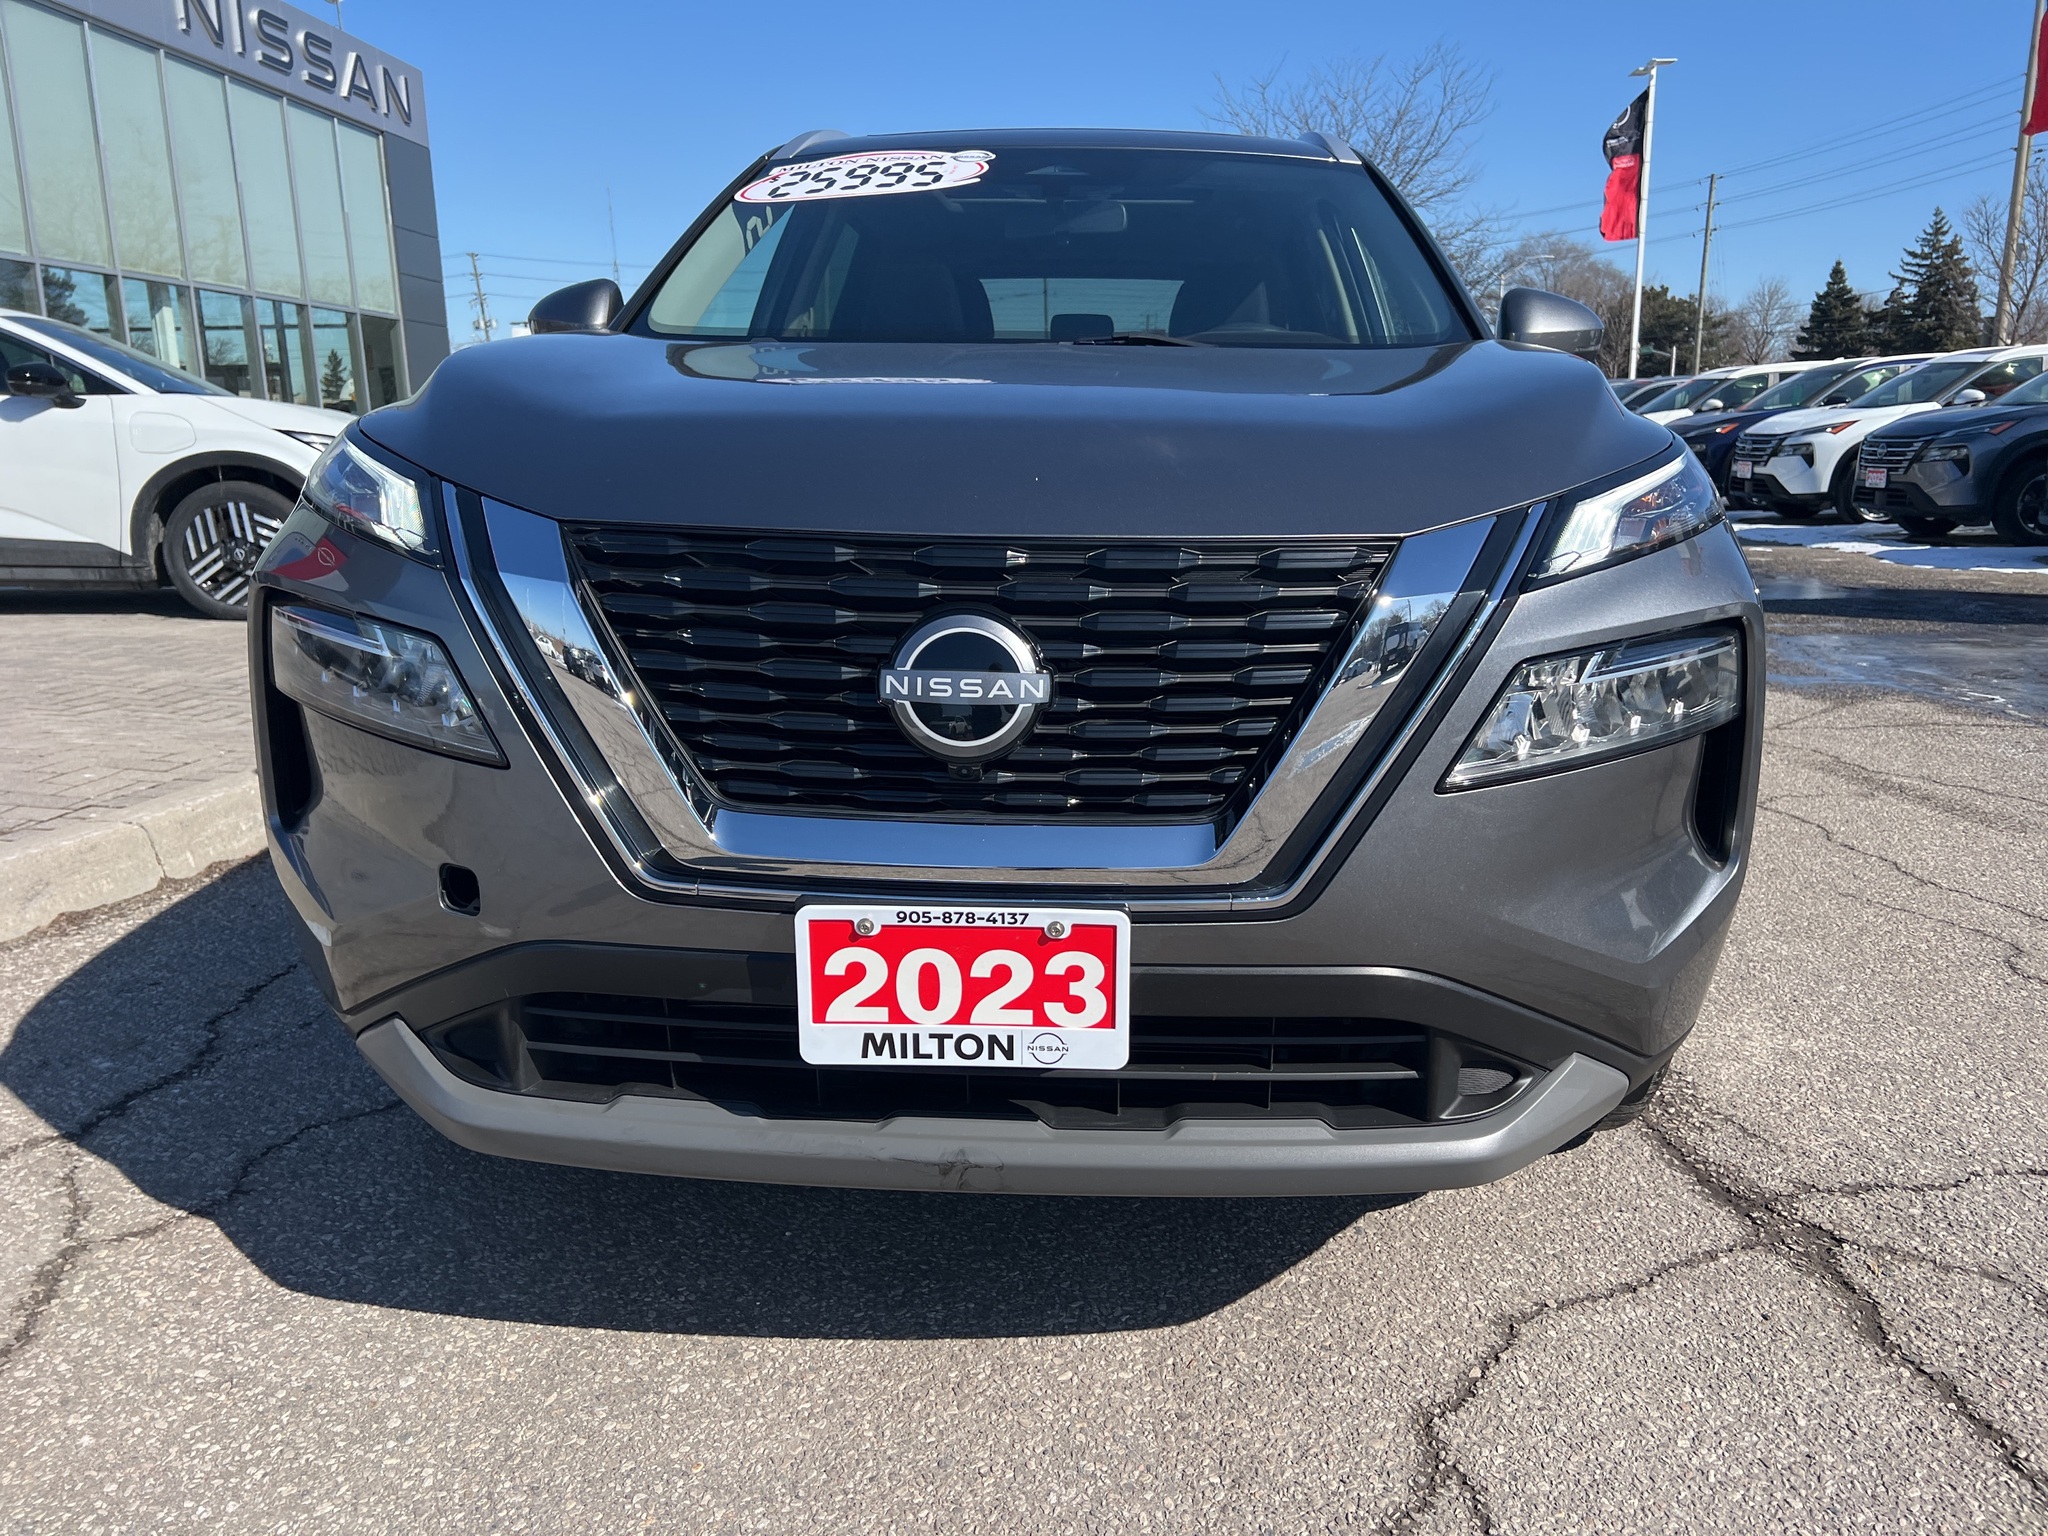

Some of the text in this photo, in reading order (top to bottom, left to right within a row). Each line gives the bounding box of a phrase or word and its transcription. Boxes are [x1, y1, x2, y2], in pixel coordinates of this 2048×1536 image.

[176, 0, 412, 125] NISSAN
[779, 154, 945, 172] MILTON NISSAN
[885, 675, 1044, 699] NISSAN
[896, 910, 1029, 925] 905-878-4137
[824, 946, 1107, 1028] 2023
[861, 1032, 1014, 1061] MILTON
[1027, 1044, 1069, 1053] NISSAN
